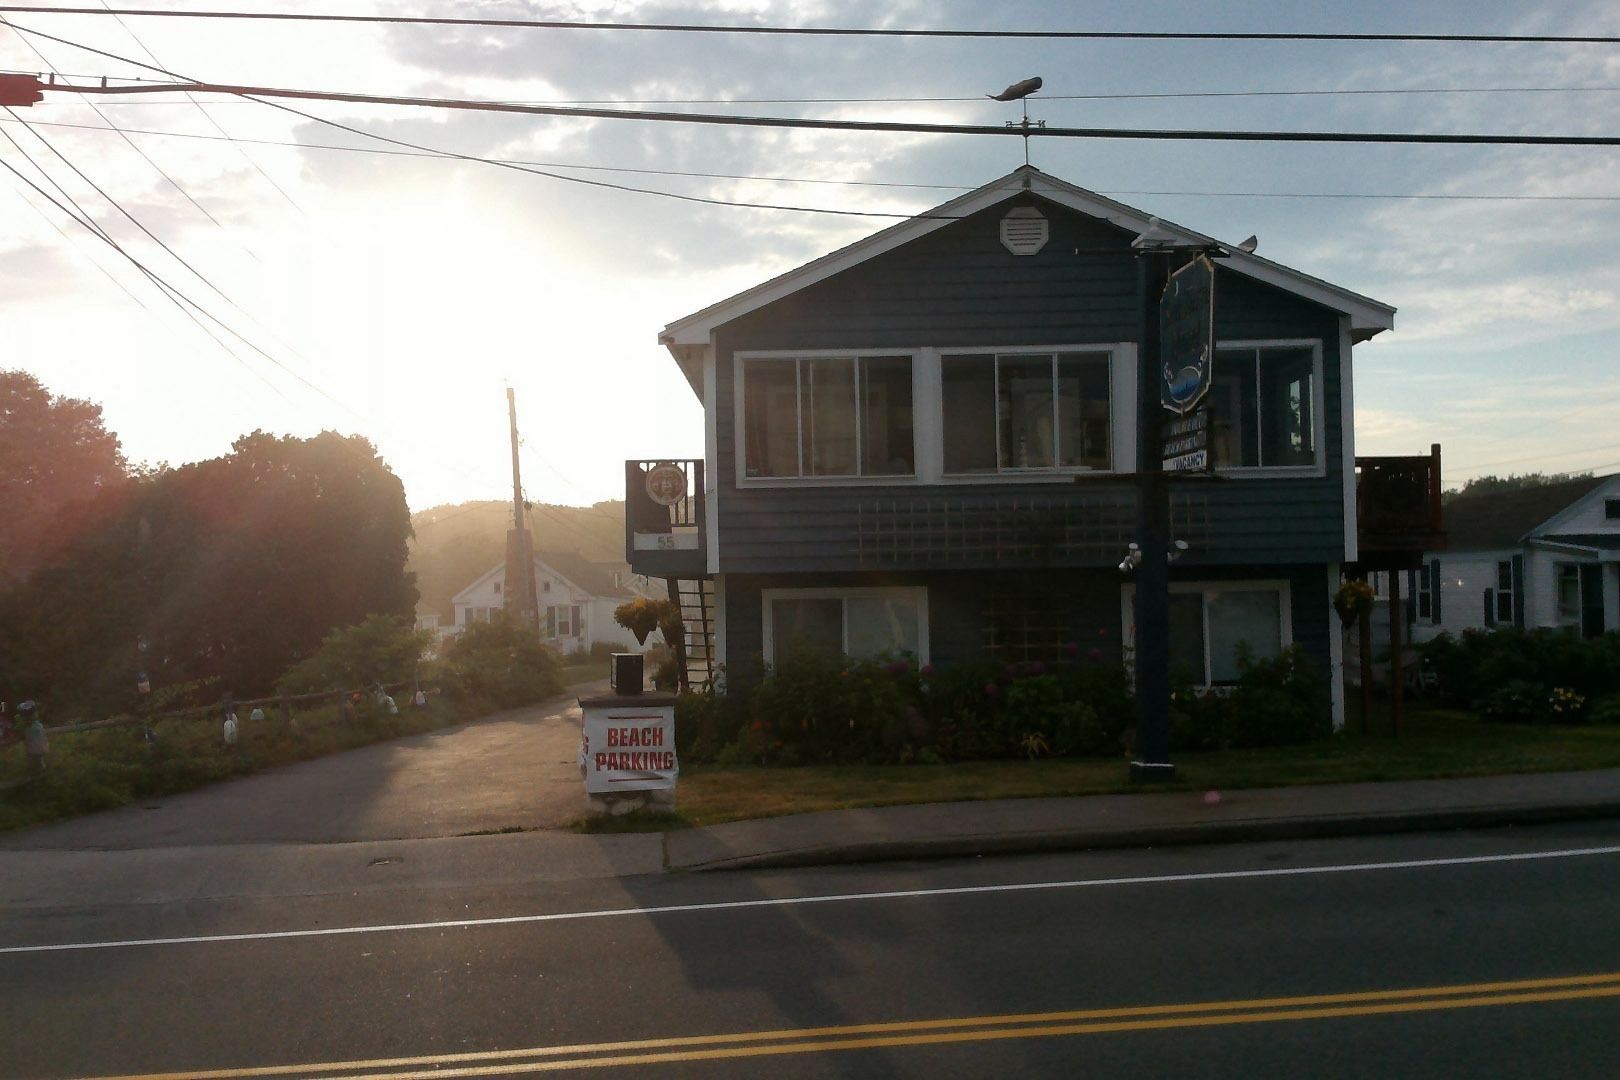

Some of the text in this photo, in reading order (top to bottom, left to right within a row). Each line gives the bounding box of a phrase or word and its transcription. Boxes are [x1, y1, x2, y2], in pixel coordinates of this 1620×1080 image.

[1174, 454, 1203, 470] VACANCY
[657, 535, 675, 548] 55
[607, 728, 664, 747] BEACH
[595, 752, 674, 772] PARKING
